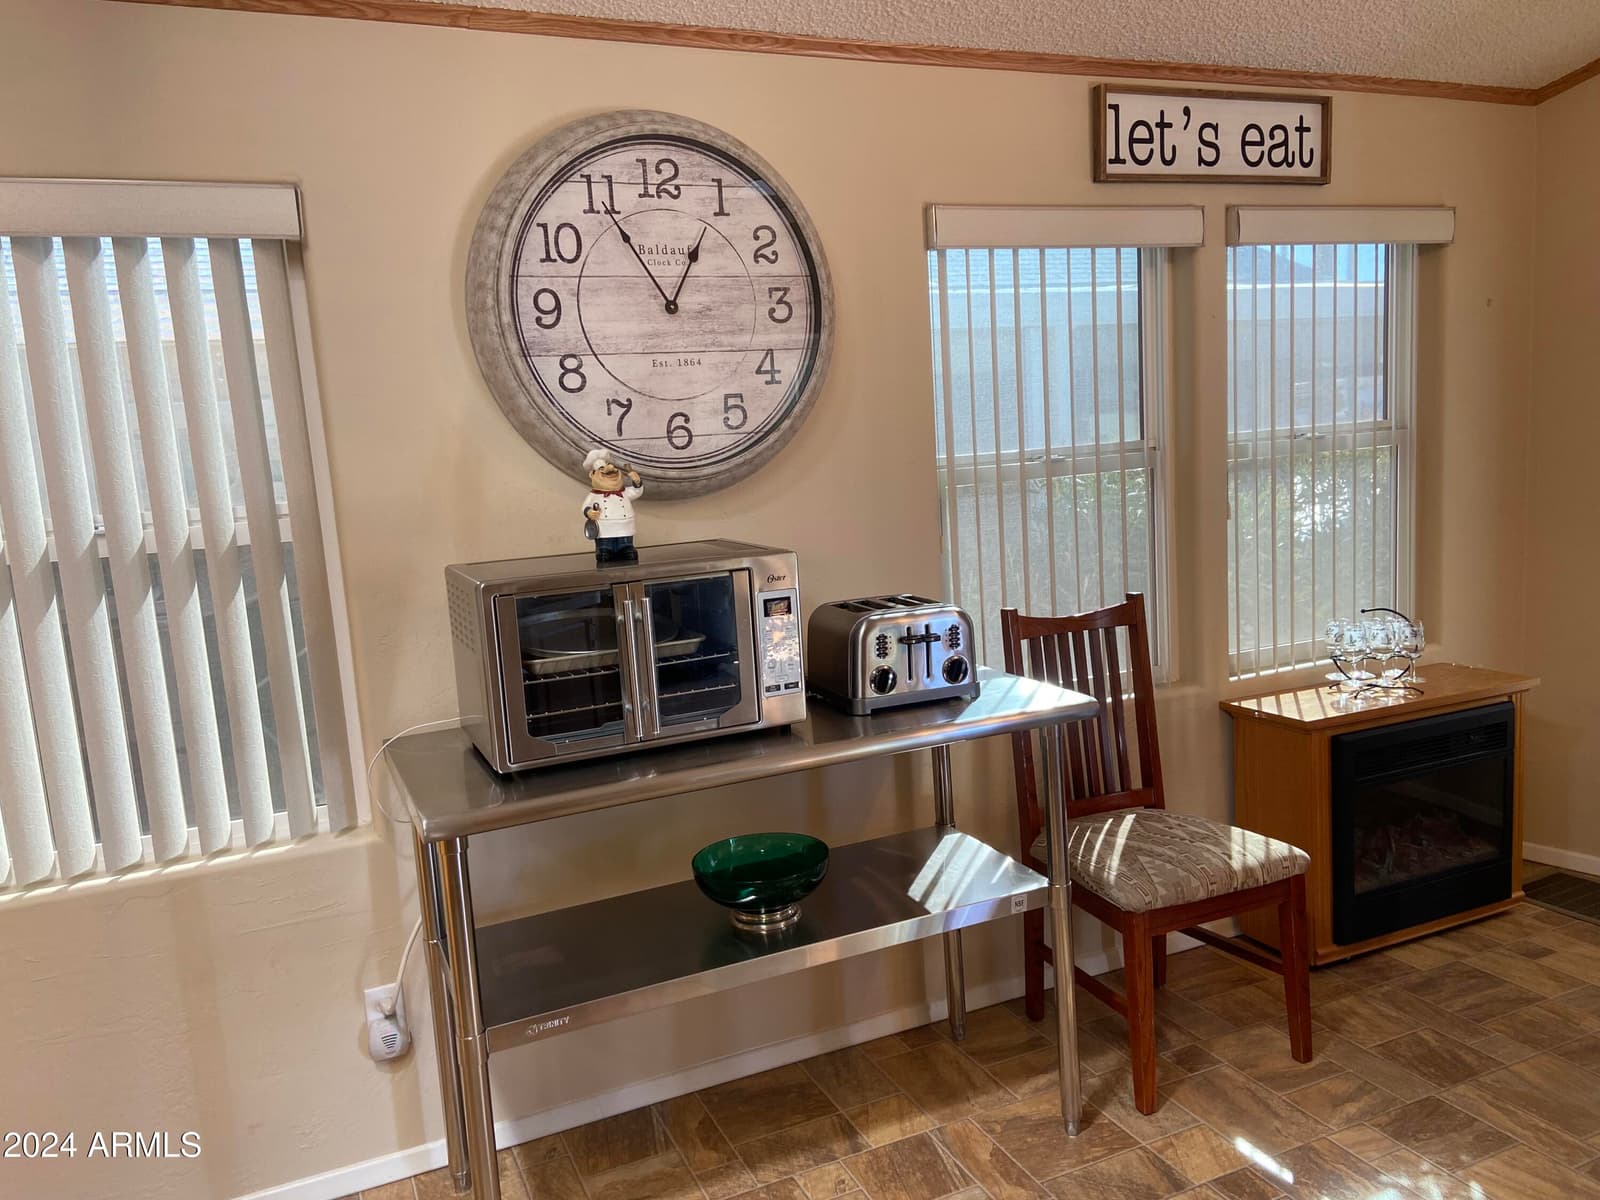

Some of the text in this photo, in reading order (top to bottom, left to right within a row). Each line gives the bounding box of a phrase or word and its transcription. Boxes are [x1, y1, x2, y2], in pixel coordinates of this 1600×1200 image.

[1107, 103, 1314, 168] let's eat
[580, 173, 622, 215] 11
[635, 158, 682, 200] 12
[711, 178, 730, 216] 1
[536, 222, 583, 264] 10
[638, 244, 693, 255] Baldauf
[647, 258, 671, 266] Clock
[752, 225, 779, 264] 2
[532, 288, 562, 329] 9
[767, 287, 793, 324] 3
[557, 353, 588, 393] 8
[652, 358, 702, 368] Est. 1864
[754, 348, 782, 385] 4
[605, 397, 632, 437] 7
[723, 393, 748, 430] 5
[666, 412, 693, 450] 6
